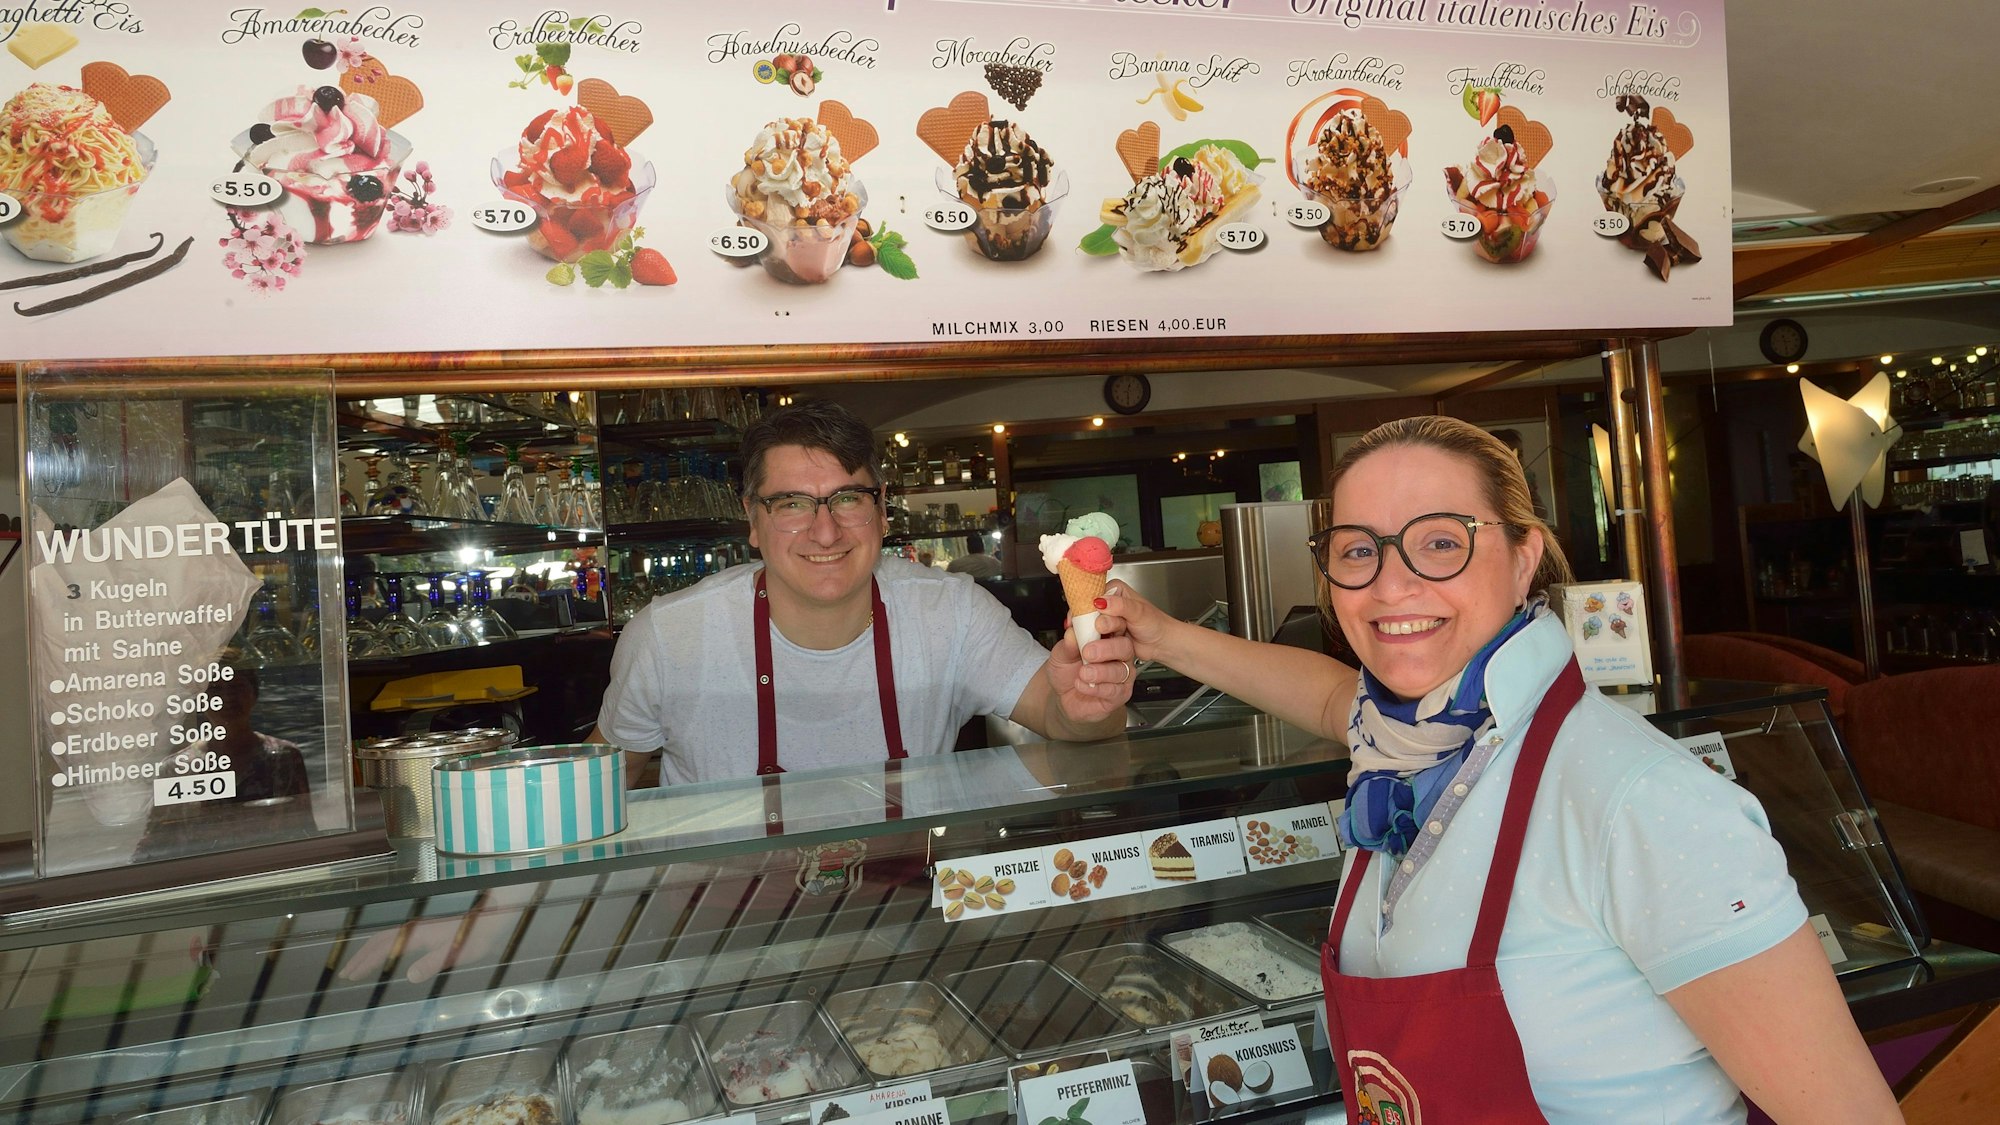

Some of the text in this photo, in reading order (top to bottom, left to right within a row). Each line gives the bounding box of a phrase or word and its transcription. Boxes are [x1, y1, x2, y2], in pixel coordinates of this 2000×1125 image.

[93, 0, 144, 34] Eis
[222, 7, 424, 49] Amarenabecher
[488, 10, 642, 53] Erdbeerbecher
[1437, 0, 1618, 34] italienisches
[1624, 4, 1669, 38] Eis
[707, 23, 879, 69] Haselnussbecher
[932, 37, 1056, 73] Moccabecher
[1109, 52, 1261, 88] Banana Split
[1286, 52, 1404, 92] Krokantbecher
[1446, 62, 1546, 96] Fruchtbecher
[1596, 69, 1681, 102] Schokobecher
[932, 321, 1019, 335] MILCHMIX
[1028, 320, 1064, 335] 3,00
[1090, 319, 1149, 332] RIESEN
[67, 578, 168, 601] 3 Kugeln
[63, 603, 234, 632] in Butterwaffel
[64, 637, 183, 663] mit Sahne
[65, 662, 234, 693] Amarena Soße
[66, 692, 224, 724] Schoko Soße
[67, 722, 227, 755] Erdbeer Soße
[67, 751, 232, 787] Himbeer Soße
[167, 777, 226, 801] 4.50
[1291, 816, 1329, 831] MANDEL
[994, 860, 1040, 877] PISTAZIE
[1091, 846, 1140, 864] WALNUSS
[1200, 1021, 1249, 1039] Zartbitter
[1235, 1039, 1296, 1062] KOKOSNUSS
[870, 1089, 906, 1103] AMARENA
[1057, 1074, 1131, 1100] PFEFFERMINZ
